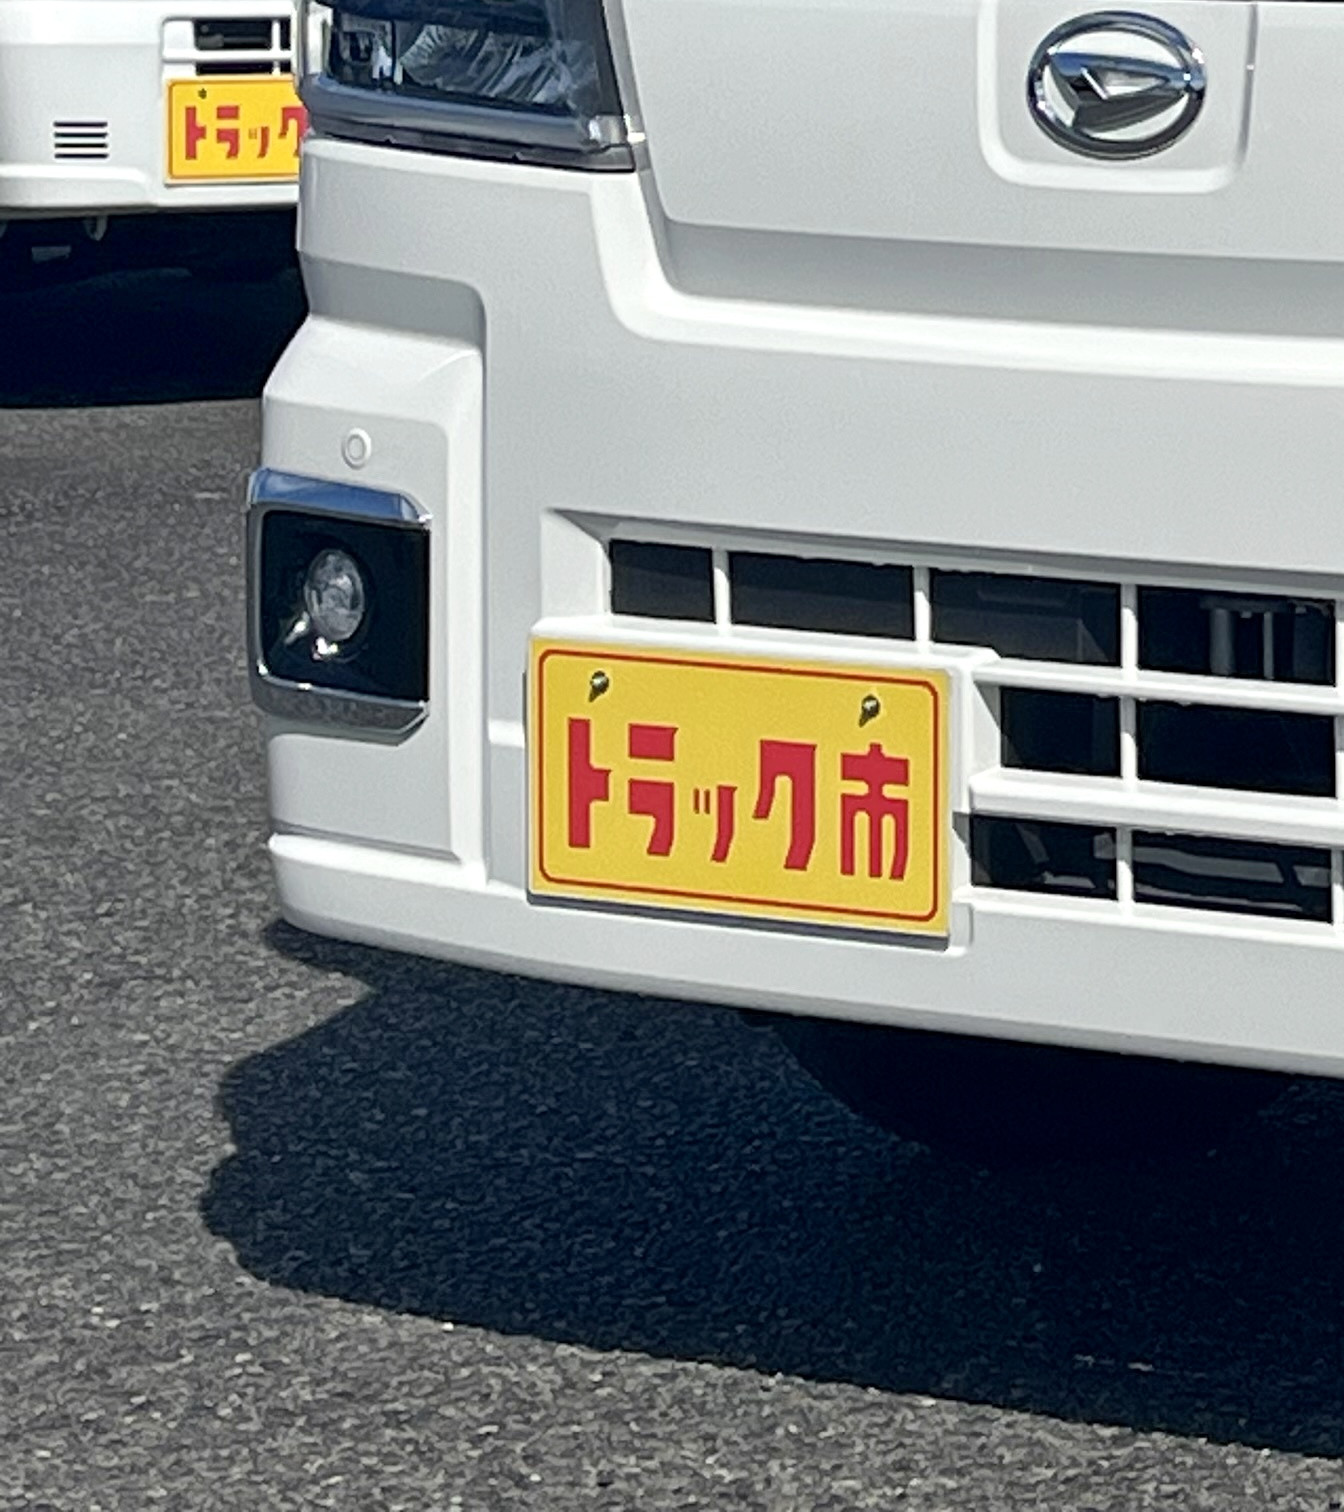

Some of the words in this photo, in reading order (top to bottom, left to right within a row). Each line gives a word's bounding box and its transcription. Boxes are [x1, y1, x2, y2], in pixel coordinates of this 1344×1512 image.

[567, 717, 911, 881] トラック市
